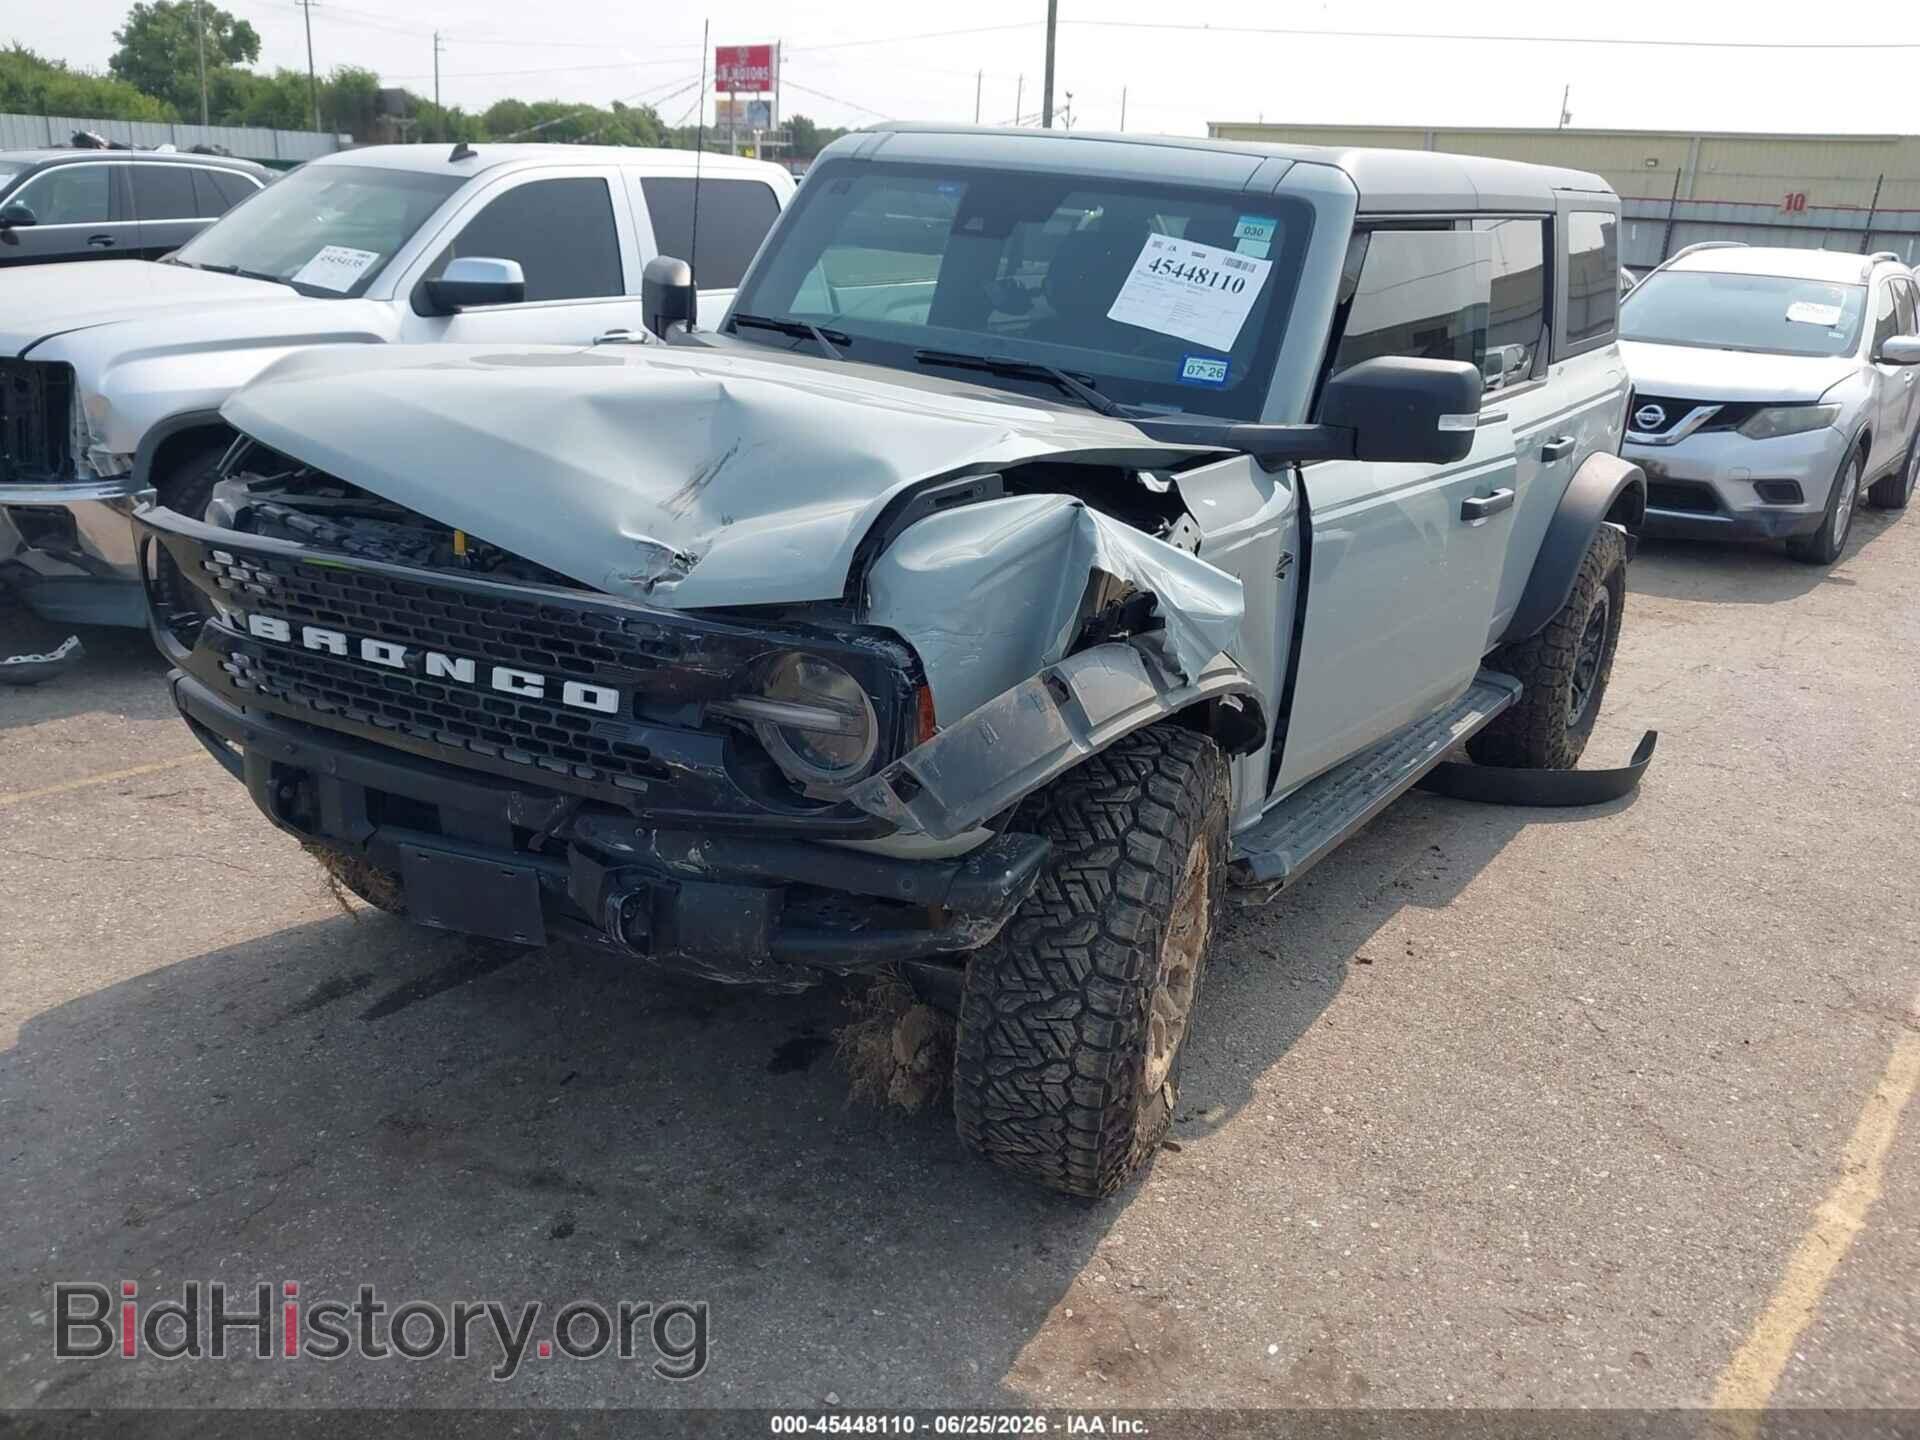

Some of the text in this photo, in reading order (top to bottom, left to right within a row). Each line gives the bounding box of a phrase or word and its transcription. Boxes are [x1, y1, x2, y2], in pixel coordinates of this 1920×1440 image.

[1785, 193, 1805, 211] 10
[1148, 257, 1246, 294] 45448110
[1187, 365, 1225, 378] 07 26
[249, 613, 620, 714] BRONCO
